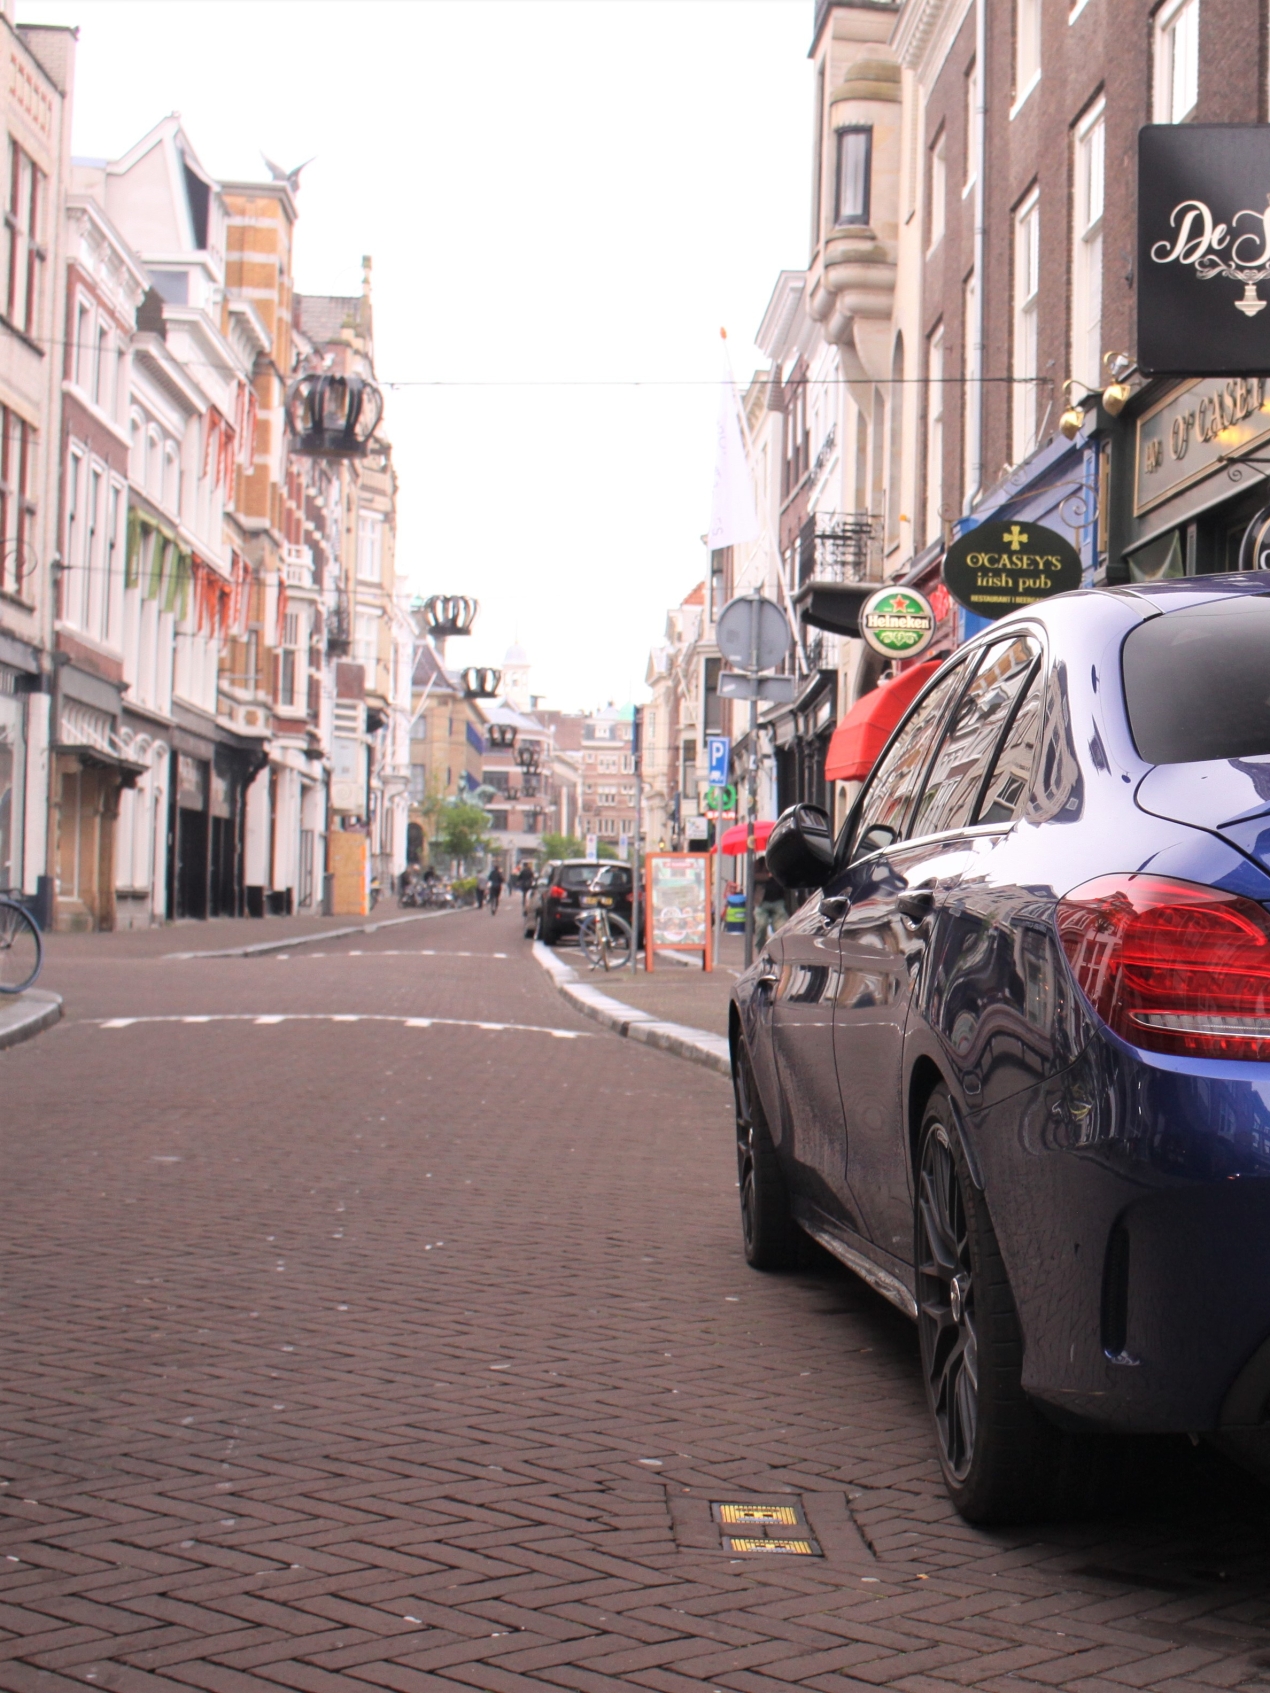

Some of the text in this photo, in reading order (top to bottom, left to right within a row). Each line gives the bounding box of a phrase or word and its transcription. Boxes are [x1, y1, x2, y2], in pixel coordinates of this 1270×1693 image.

[1151, 200, 1231, 265] De
[966, 552, 1062, 571] O'CASEY'S
[976, 572, 1052, 592] irish pub
[867, 614, 930, 630] Heineken
[711, 742, 724, 767] P
